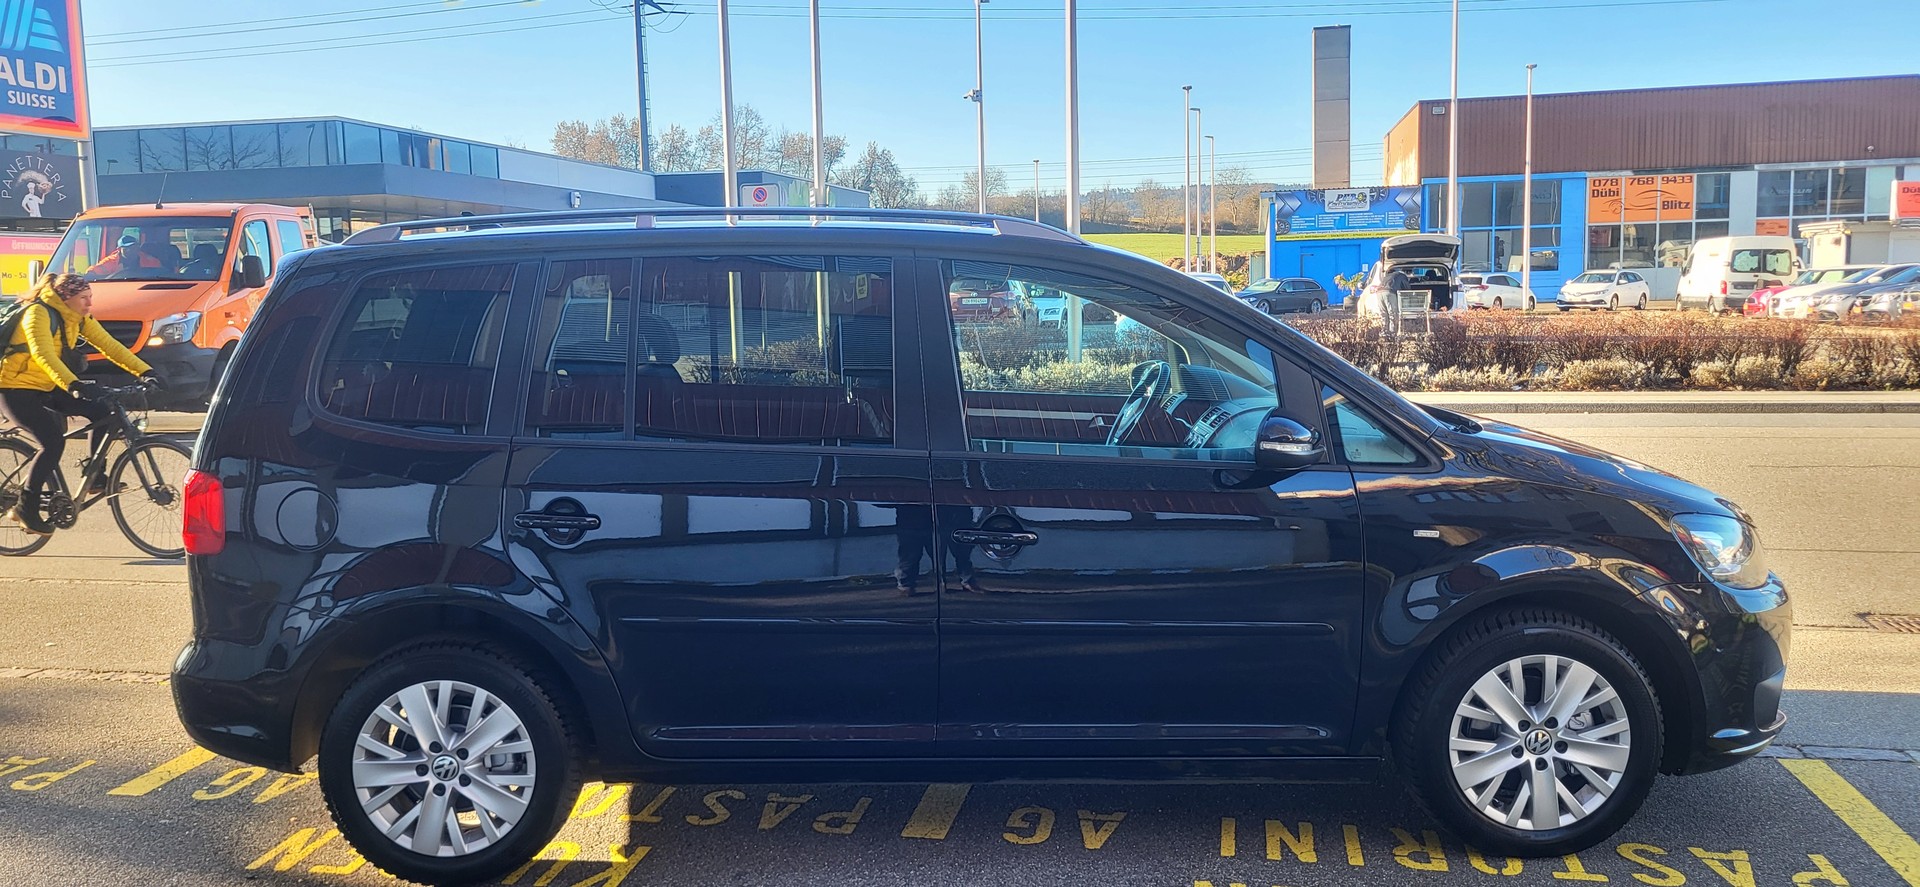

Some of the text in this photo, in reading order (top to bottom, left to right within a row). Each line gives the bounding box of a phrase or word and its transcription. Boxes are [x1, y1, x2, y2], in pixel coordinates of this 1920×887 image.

[0, 55, 67, 94] ALDI
[7, 90, 56, 110] SUISSE
[1, 155, 67, 202] PANETTERIA
[1592, 175, 1693, 188] 078 768 9433
[1592, 188, 1620, 198] Dübi
[1662, 200, 1690, 210] Blitz
[1003, 806, 1127, 850] AG
